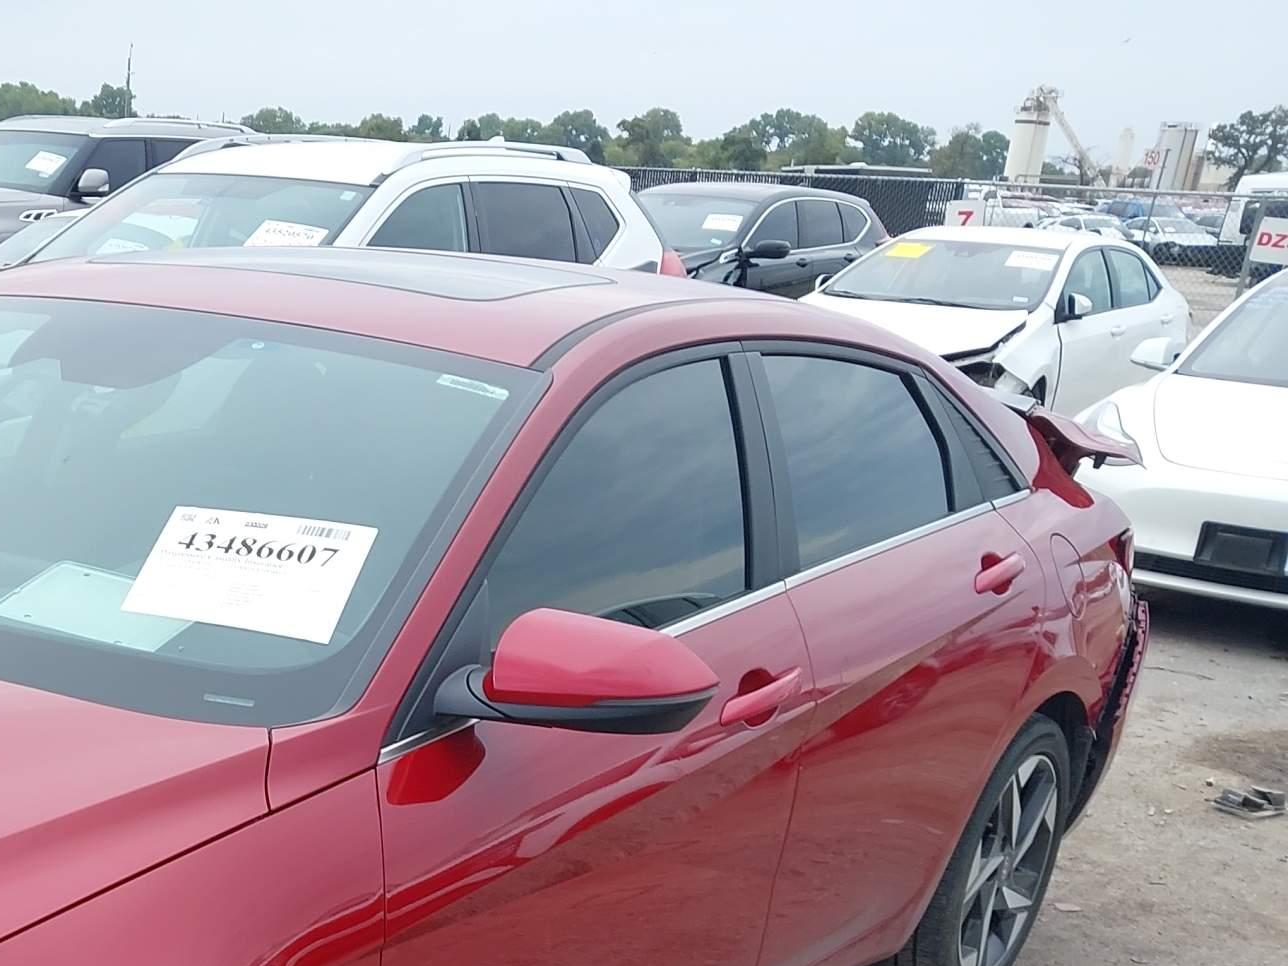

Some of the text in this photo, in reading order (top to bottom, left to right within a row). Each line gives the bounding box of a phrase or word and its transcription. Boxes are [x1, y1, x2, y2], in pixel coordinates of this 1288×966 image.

[1144, 150, 1160, 165] 150
[958, 210, 974, 226] 7
[1257, 231, 1288, 248] DZ
[178, 531, 340, 567] 43486607
